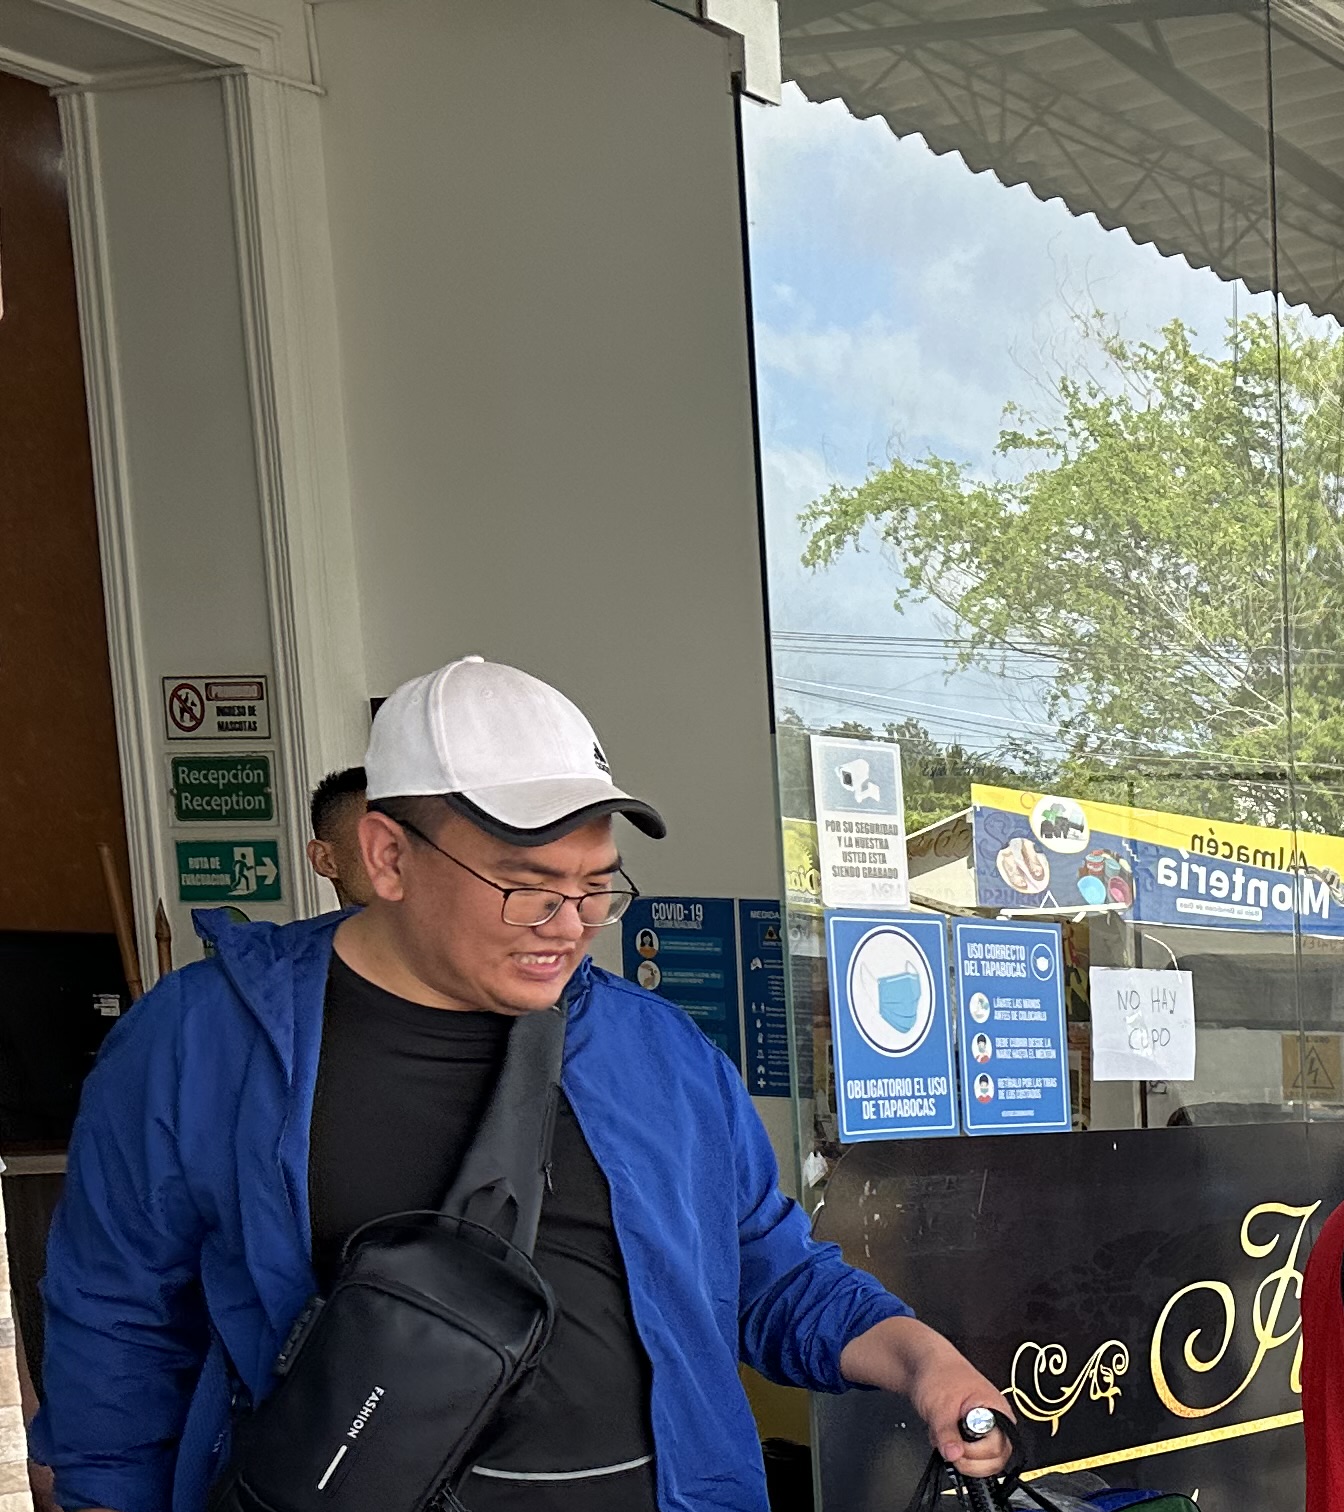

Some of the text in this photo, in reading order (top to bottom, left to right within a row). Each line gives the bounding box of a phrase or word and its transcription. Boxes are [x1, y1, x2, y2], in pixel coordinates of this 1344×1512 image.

[217, 720, 257, 732] MASCOTAS
[178, 764, 264, 790] Recepción
[181, 792, 265, 815] Reception
[825, 820, 898, 836] POR SU SEGURIDAD
[844, 836, 853, 848] LA
[854, 837, 889, 850] NUESTRA
[842, 851, 887, 864] USTED ESTA
[832, 865, 898, 879] SIENDO GRABADO
[652, 902, 704, 921] COVID-19
[967, 942, 1026, 960] USO CORRECTO
[963, 960, 1027, 978] DEL TAPABOCAS
[1117, 985, 1177, 1015] NO HAY
[846, 1076, 948, 1099] OBLIGATORIO EL USO
[862, 1097, 936, 1120] DE TAPABOCAS
[346, 1386, 385, 1439] FASHION
